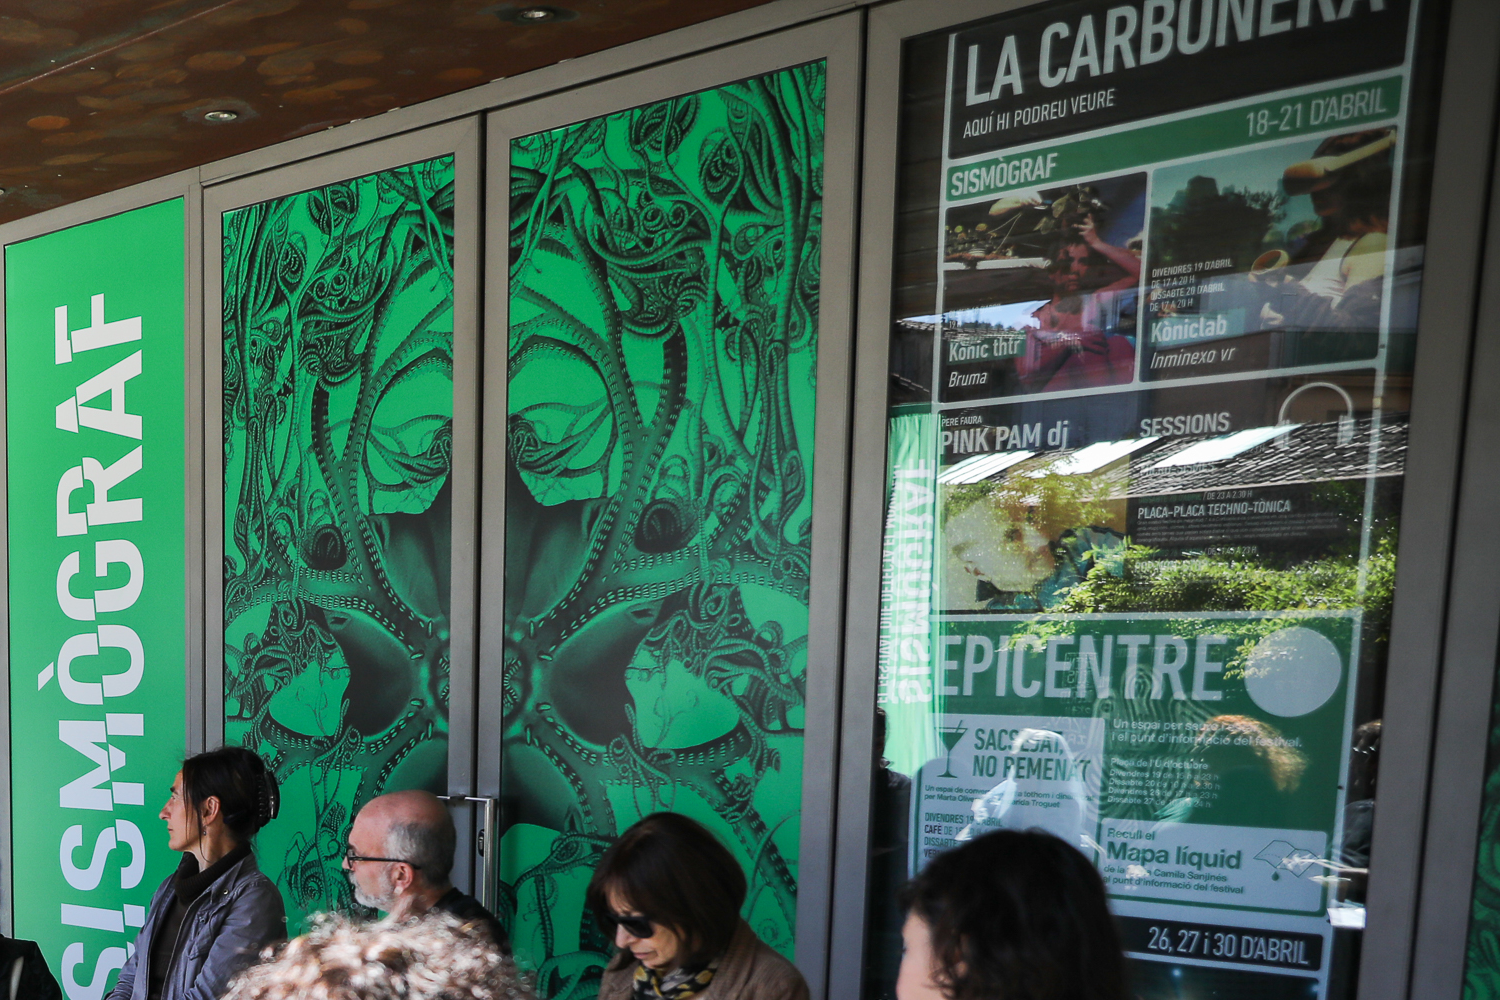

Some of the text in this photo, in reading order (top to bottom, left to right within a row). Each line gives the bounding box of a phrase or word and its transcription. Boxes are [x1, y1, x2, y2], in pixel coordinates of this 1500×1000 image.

[965, 0, 1386, 107] LA CARBONE
[962, 87, 1116, 139] AQUÍ HI PODREU VEURE
[1308, 86, 1387, 127] D'ABRIL
[950, 151, 1060, 197] SISMÒGRAF
[1153, 259, 1232, 277] DIVENDRES 19 D'ABRIL
[1151, 279, 1160, 289] DE
[1162, 278, 1170, 287] 17
[1178, 275, 1188, 286] 20
[1186, 285, 1195, 297] 20
[1151, 315, 1227, 342] Kòniclab
[992, 337, 1020, 357] thtr
[1220, 346, 1237, 362] vr
[948, 371, 989, 388] Bruma
[941, 415, 982, 427] PERE FAURA
[1139, 412, 1231, 438] SESSIONS
[939, 420, 1069, 455] PINK PAM dj
[938, 634, 1229, 701] EPICENTRE
[1113, 718, 1129, 730] Un
[1131, 719, 1161, 732] espai
[1163, 722, 1182, 733] per
[1118, 732, 1128, 742] el
[1129, 732, 1155, 744] punt
[1233, 735, 1252, 746] del
[972, 755, 998, 778] NO
[1201, 773, 1212, 781] 23
[924, 785, 934, 793] Un
[935, 786, 953, 795] espai
[1024, 791, 1050, 799] tothom
[1200, 791, 1211, 799] 23
[924, 812, 964, 824] DIVENDRES
[924, 823, 942, 835] CAFÈ
[1107, 828, 1155, 841] Recull el
[1106, 841, 1242, 871] Mapa líquid
[1104, 864, 1115, 874] de
[1154, 868, 1185, 880] Camila
[1112, 877, 1133, 887] punt
[1134, 876, 1190, 891] d'informació
[1192, 882, 1207, 892] del
[1209, 884, 1244, 894] festival
[1147, 927, 1173, 954] 26,
[1177, 929, 1199, 955] 27
[1213, 932, 1236, 958] 30
[1241, 935, 1310, 966] D'ABRIL
